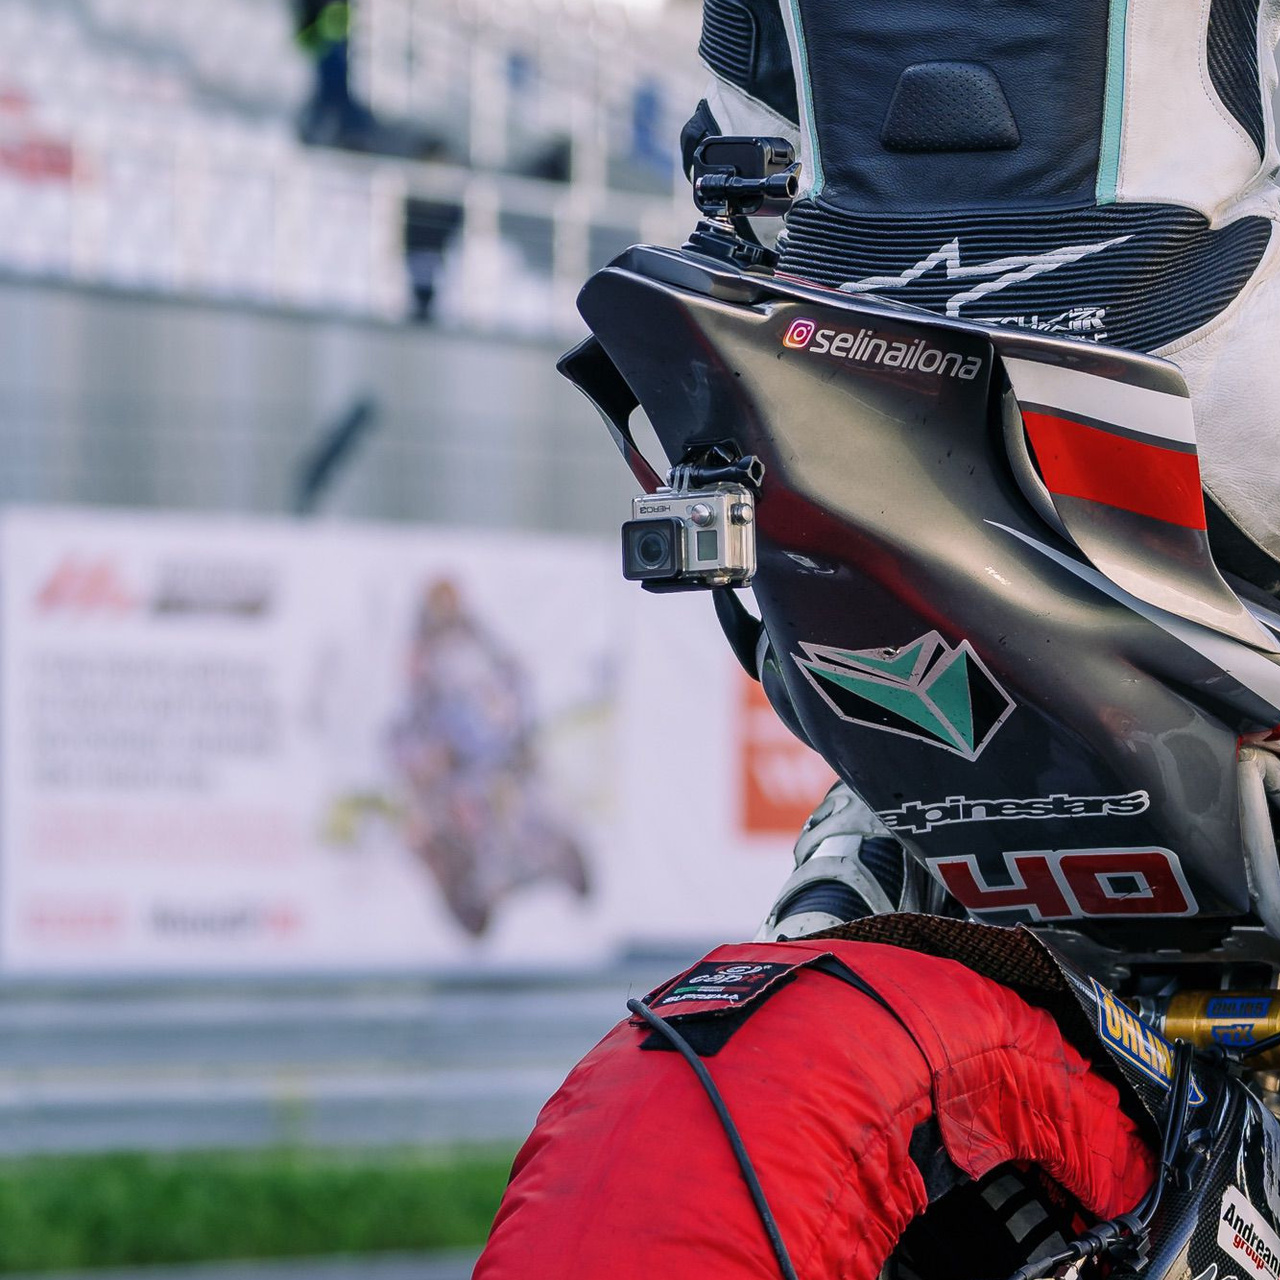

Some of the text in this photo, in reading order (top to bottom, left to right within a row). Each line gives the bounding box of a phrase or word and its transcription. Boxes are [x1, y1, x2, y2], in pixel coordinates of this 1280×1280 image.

[809, 327, 983, 381] selinailona
[639, 504, 671, 515] HERO3
[875, 789, 1150, 834] alpinestars
[925, 846, 1199, 921] 40
[1101, 986, 1175, 1081] ÖHLIN
[1233, 1233, 1265, 1271] group
